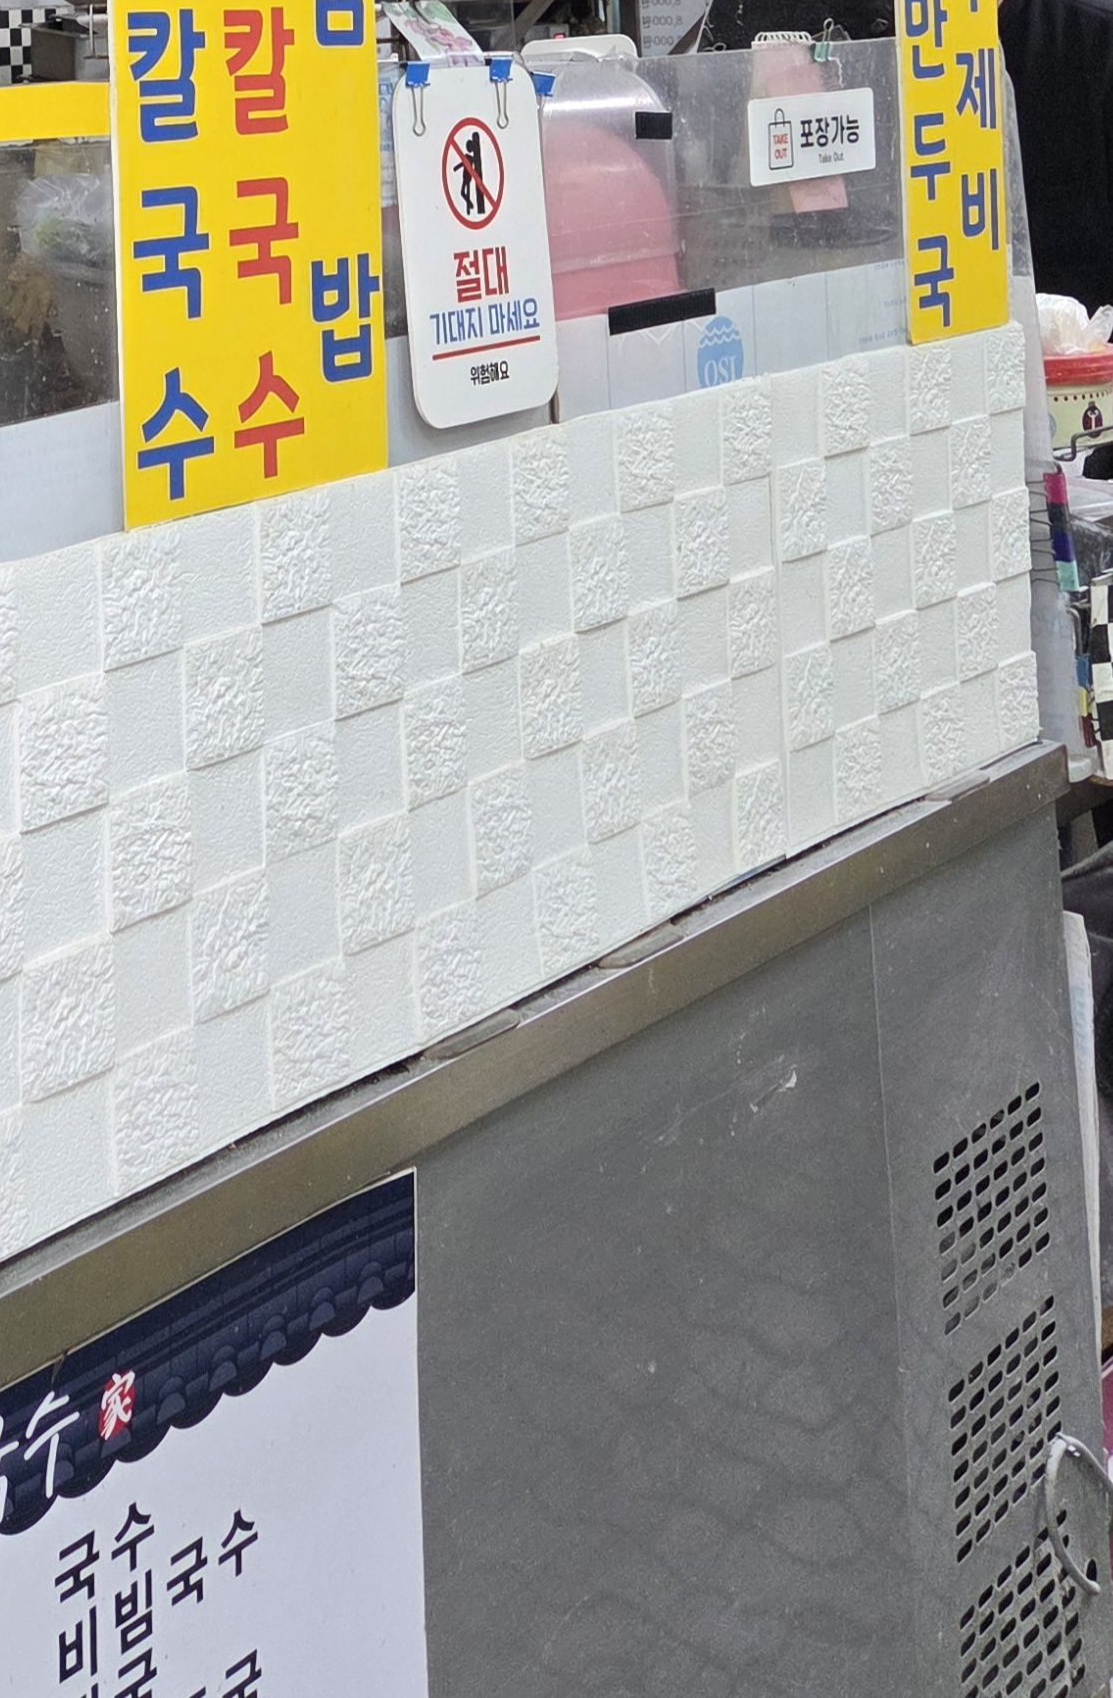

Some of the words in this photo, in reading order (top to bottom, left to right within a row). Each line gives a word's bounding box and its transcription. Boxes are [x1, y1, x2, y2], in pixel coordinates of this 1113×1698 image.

[800, 114, 859, 148] 포장가능
[453, 246, 509, 303] 절대
[429, 306, 483, 345] 기대지
[488, 297, 540, 338] 마세요
[470, 360, 510, 386] 위험해요
[55, 1502, 155, 1603] 국수
[59, 1509, 258, 1684] 비빔국수
